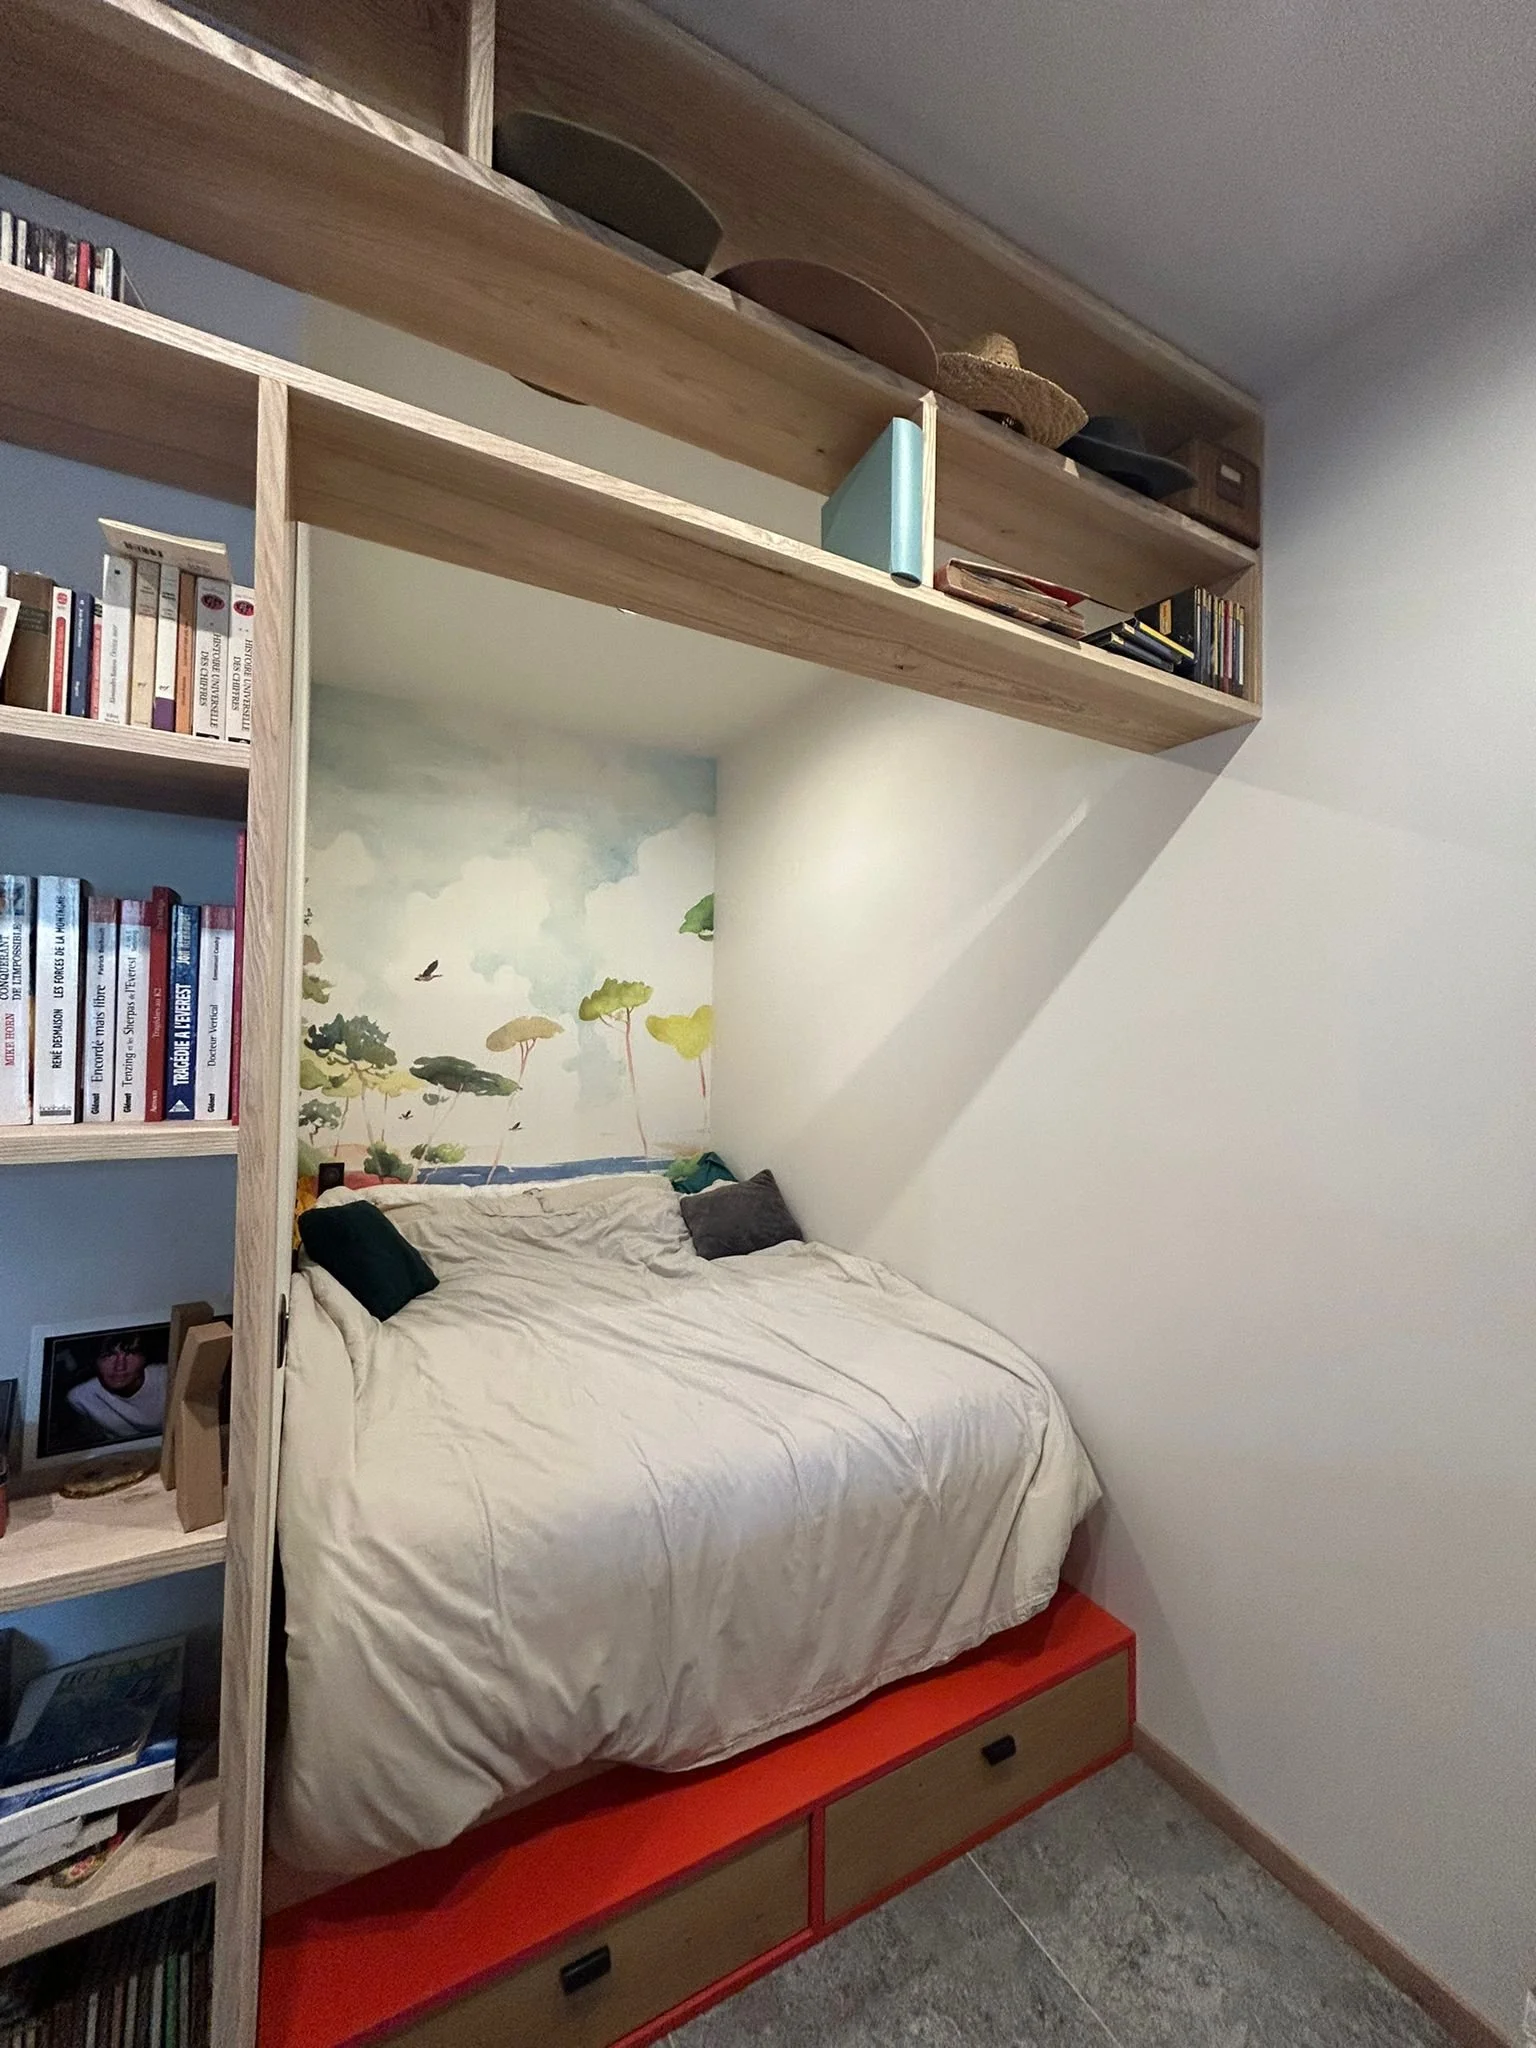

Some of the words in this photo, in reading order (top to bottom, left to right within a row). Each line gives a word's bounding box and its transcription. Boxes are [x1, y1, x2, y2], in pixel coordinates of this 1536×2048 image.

[200, 650, 209, 667] DES
[212, 633, 222, 673] HISTOIRE
[232, 656, 241, 672] DES
[242, 638, 253, 677] HISTOIRE
[199, 667, 209, 708] CHIFFRES
[209, 674, 220, 729] UNIVERSELLE
[231, 672, 241, 711] CHIFFRES
[241, 678, 252, 732] UNIVERSELLE
[55, 895, 66, 933] MONTAGNE
[12, 924, 22, 985] L'IMPOSSIBLE
[55, 936, 65, 944] LA
[55, 946, 65, 956] DE
[54, 958, 64, 984] FORCES
[176, 951, 191, 965] Jon
[125, 957, 137, 993] l'Everest
[12, 987, 22, 1000] DE
[54, 986, 64, 998] LES
[93, 984, 106, 1008] libre
[153, 988, 162, 997] K2
[173, 983, 192, 1029] L'EVEREST
[4, 1013, 15, 1040] HORN
[52, 1008, 64, 1048] DESMAISON
[94, 1012, 105, 1036] mais
[123, 1001, 137, 1035] Sherpas
[208, 1004, 219, 1033] Vertical
[173, 1031, 191, 1039] A
[4, 1042, 15, 1066] MIKE
[50, 1050, 63, 1069] RENÉ
[91, 1039, 105, 1082] Encordé
[170, 1041, 191, 1086] TRAGÉDIE
[207, 1036, 218, 1067] Docteur
[121, 1052, 135, 1087] Tenzing
